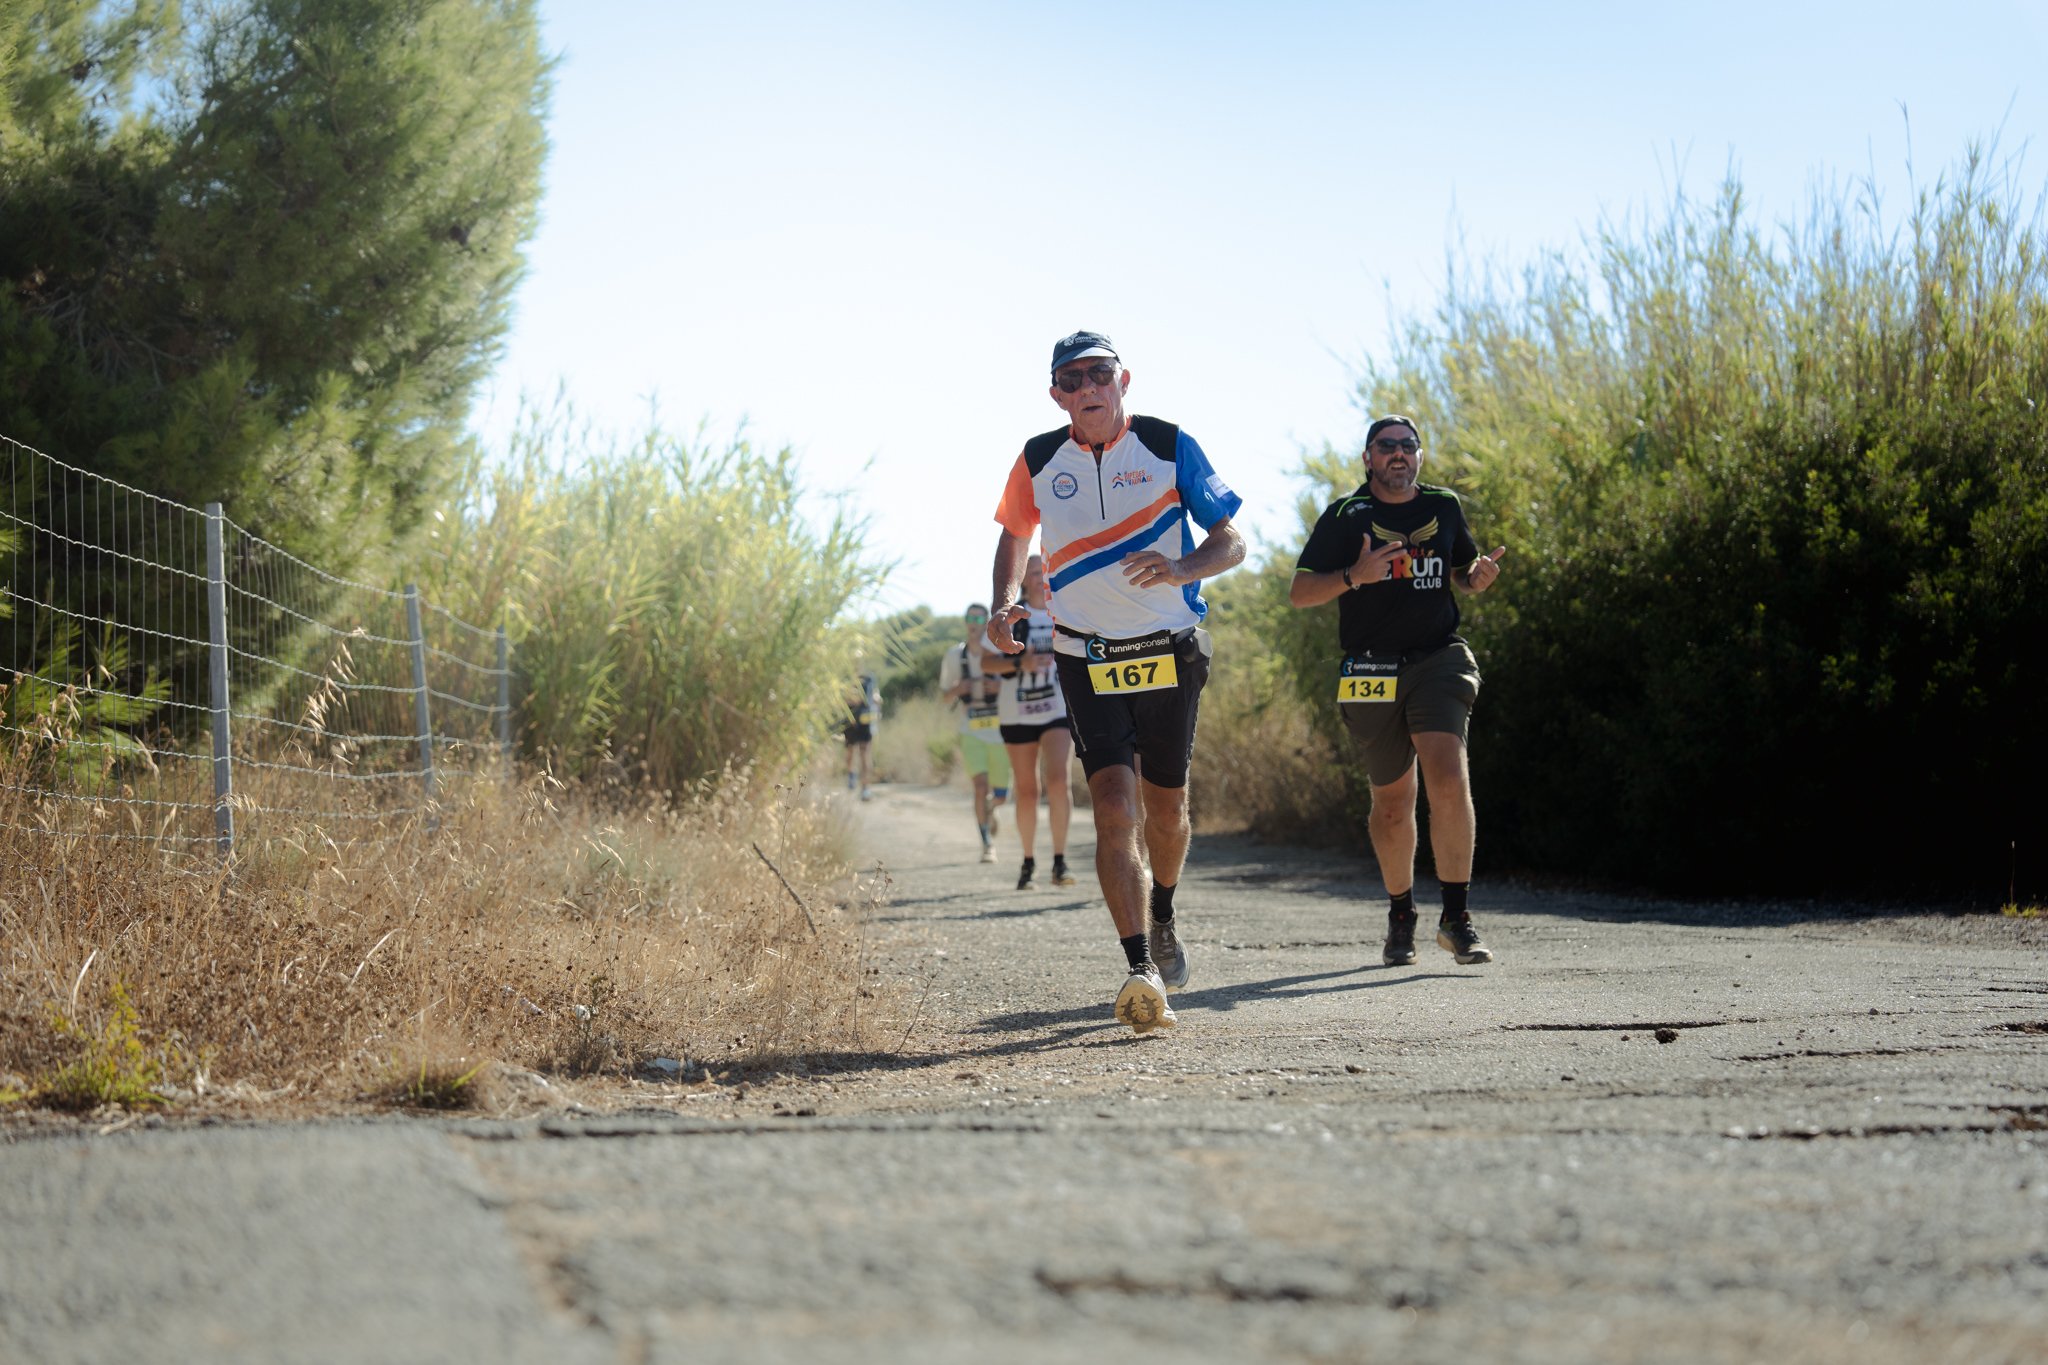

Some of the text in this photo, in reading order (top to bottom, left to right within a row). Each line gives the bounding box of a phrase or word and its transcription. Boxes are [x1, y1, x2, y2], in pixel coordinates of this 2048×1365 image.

[1413, 579, 1442, 590] CLUB
[1109, 637, 1170, 654] runningconseil
[1105, 661, 1159, 688] 167
[1348, 680, 1386, 697] 134
